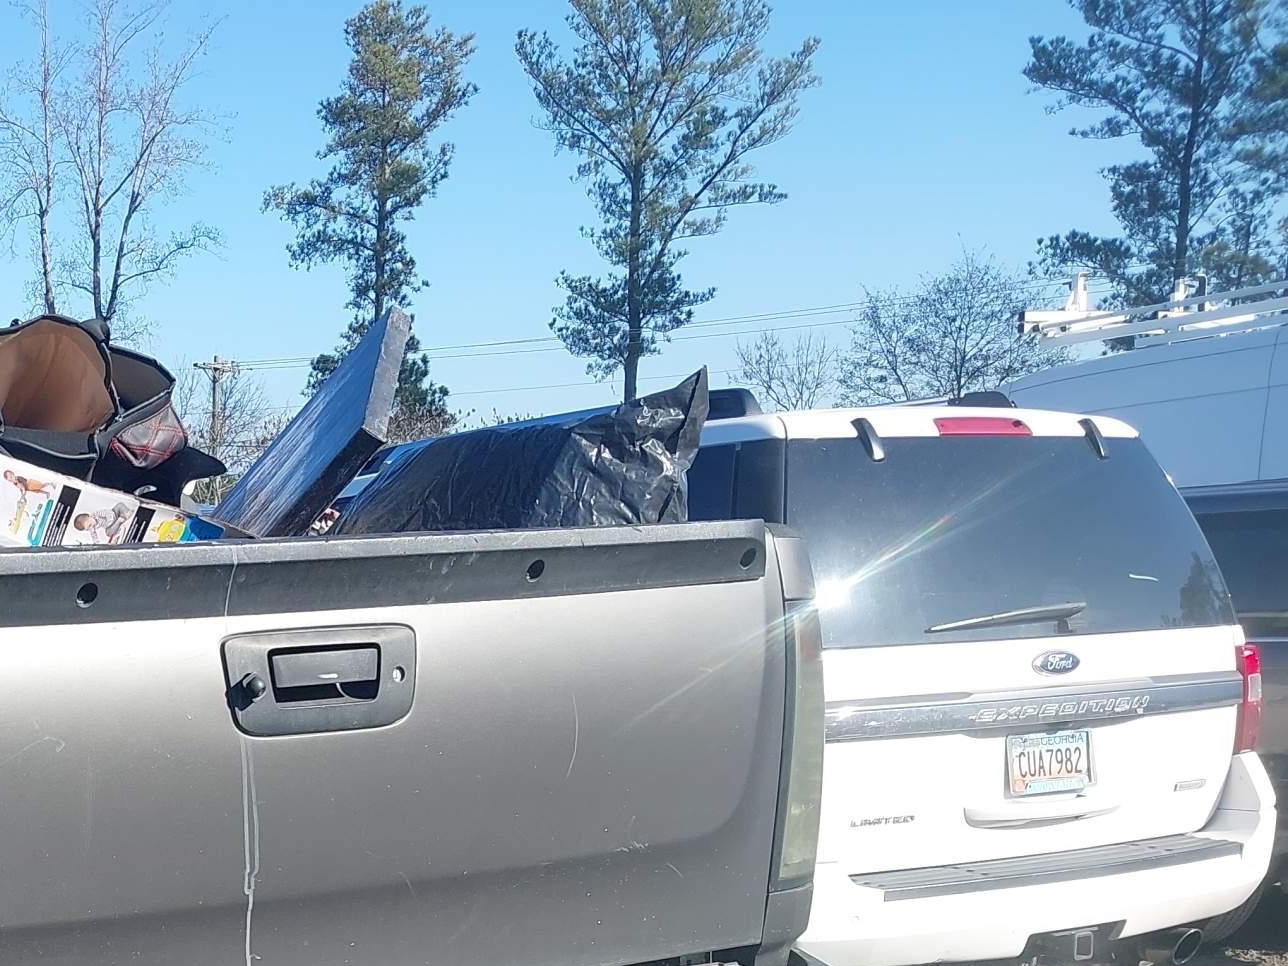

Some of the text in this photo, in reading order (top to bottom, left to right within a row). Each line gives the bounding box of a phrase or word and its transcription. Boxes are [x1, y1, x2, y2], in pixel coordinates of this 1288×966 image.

[975, 695, 1150, 722] EXPEDITION
[1040, 732, 1085, 746] GEORGIA
[1018, 746, 1084, 778] CUA7982
